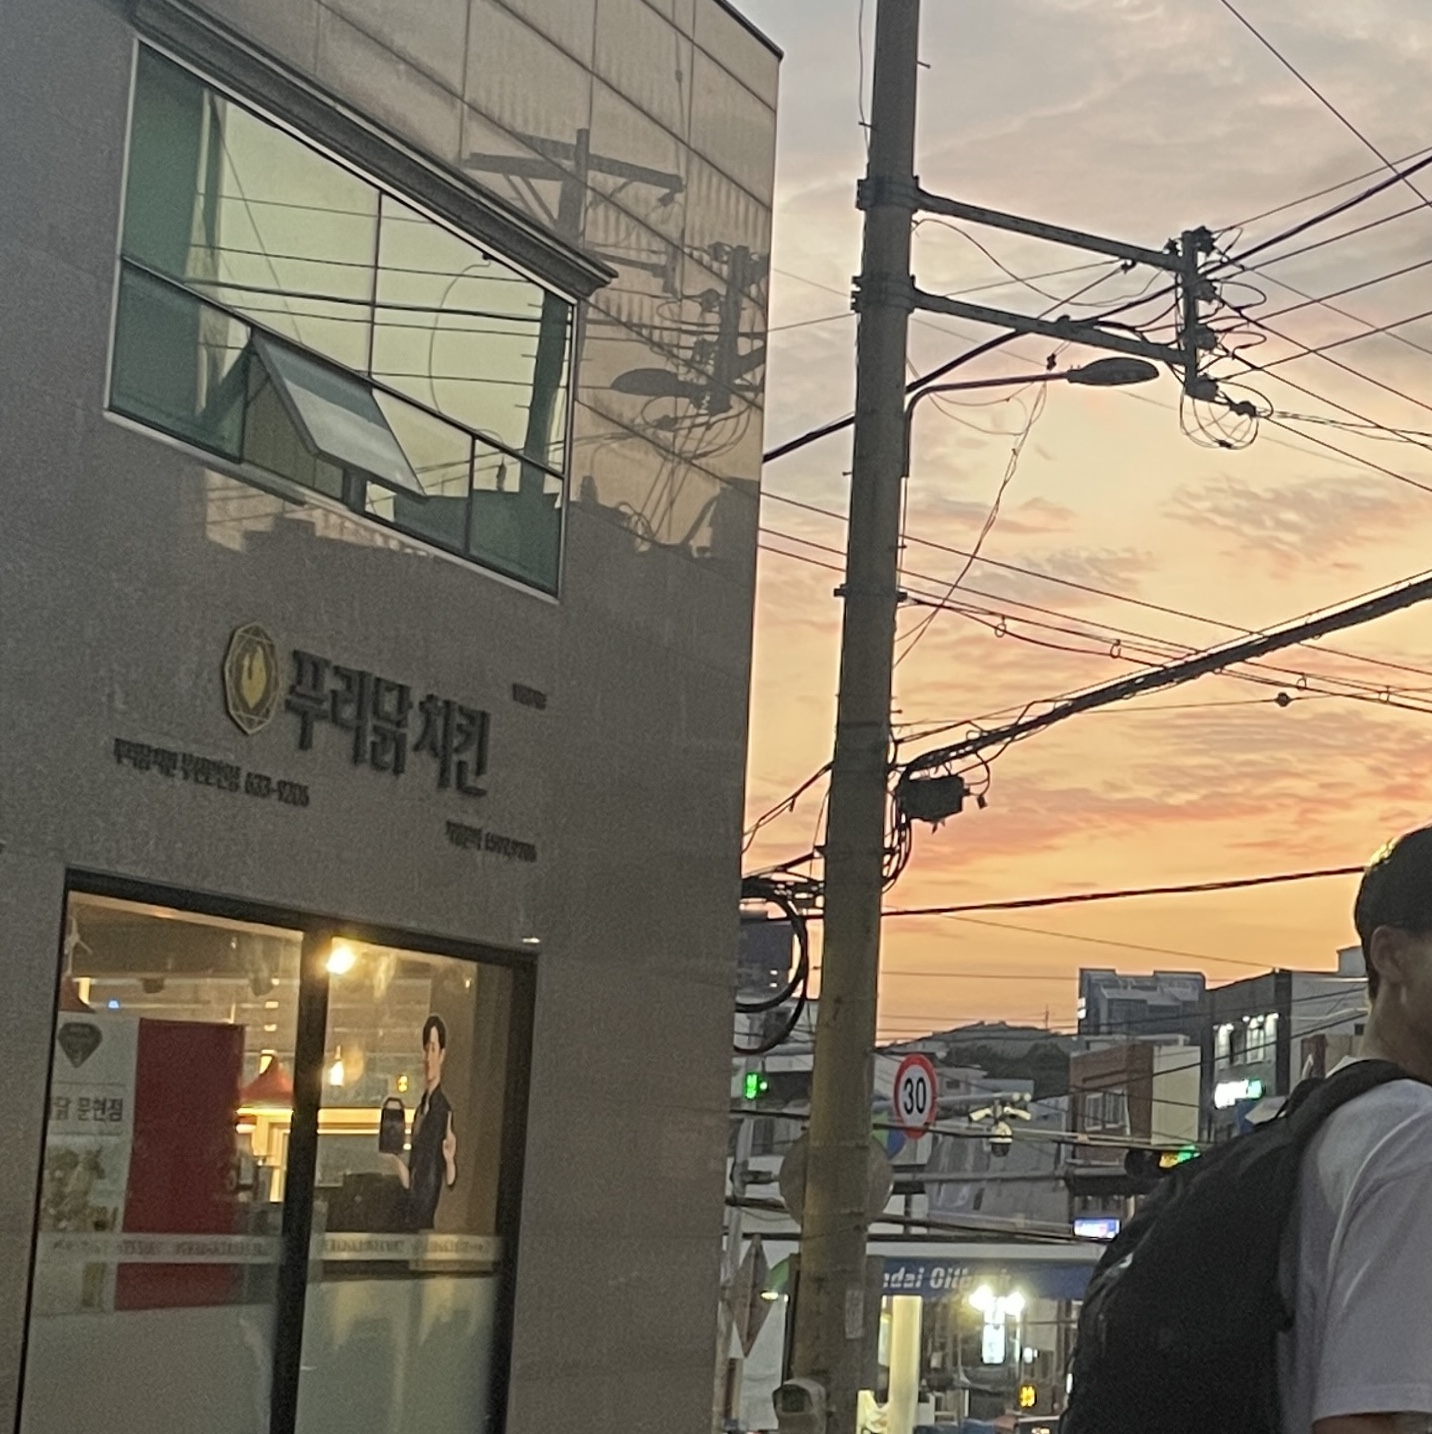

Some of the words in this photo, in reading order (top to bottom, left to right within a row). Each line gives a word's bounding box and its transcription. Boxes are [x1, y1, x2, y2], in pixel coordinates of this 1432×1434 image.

[412, 693, 492, 797] 치킨
[77, 1097, 124, 1123] 문현점
[903, 1077, 927, 1115] 30
